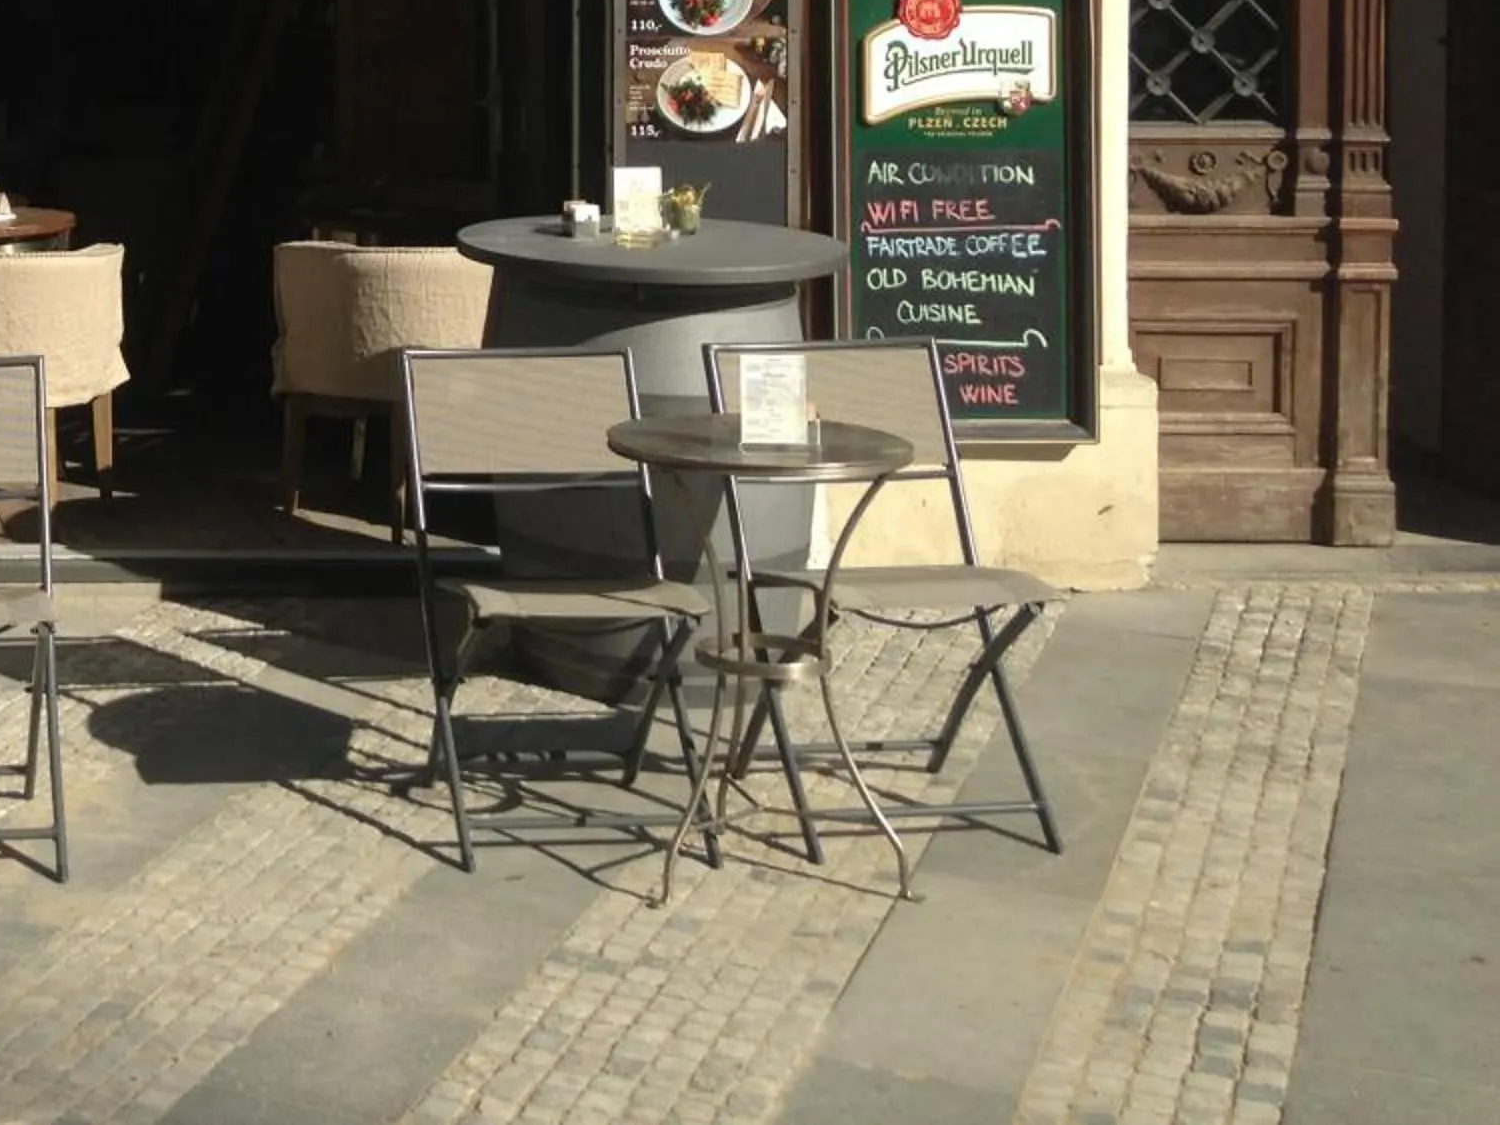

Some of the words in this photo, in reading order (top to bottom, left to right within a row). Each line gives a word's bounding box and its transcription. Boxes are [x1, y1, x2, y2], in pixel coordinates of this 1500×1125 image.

[631, 18, 662, 32] 110,-
[629, 44, 691, 56] Prosciutto
[629, 57, 669, 69] Crudo
[884, 39, 961, 92] Pilsner
[959, 37, 1033, 77] Urquell
[963, 115, 1008, 128] CZECH
[867, 161, 903, 184] AIR
[932, 199, 996, 221] FREE
[866, 235, 961, 258] FAIRTRADE
[965, 233, 1048, 258] COFFEE
[867, 268, 907, 290] OLD
[921, 268, 1035, 296] BOHEMIAN
[896, 300, 983, 325] CUISINE
[943, 351, 1026, 377] SPIRITS
[959, 384, 1020, 405] WINE
